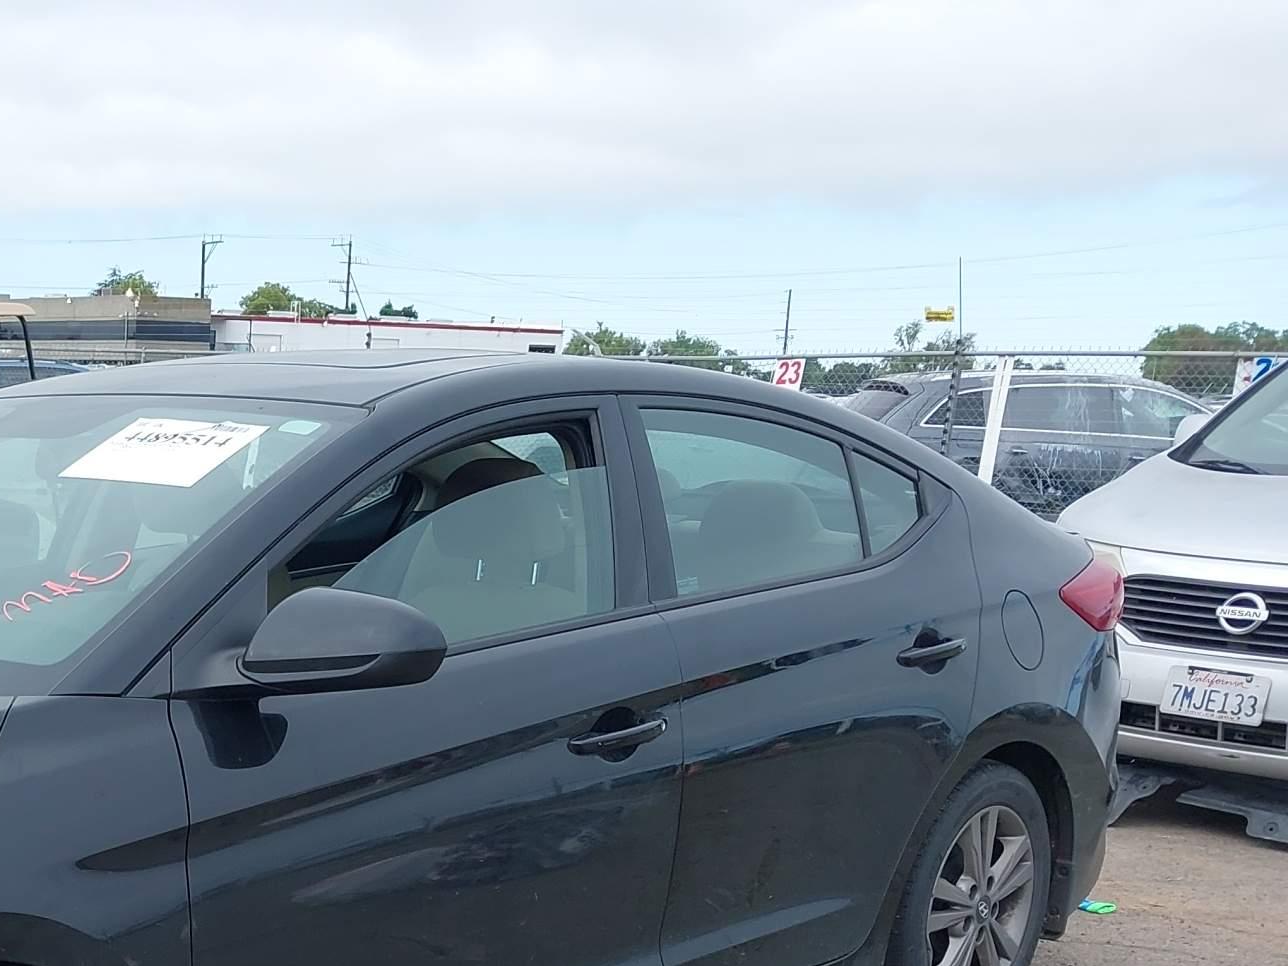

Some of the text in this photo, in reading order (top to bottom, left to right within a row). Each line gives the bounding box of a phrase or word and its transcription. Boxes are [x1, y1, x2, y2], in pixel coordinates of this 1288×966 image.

[776, 361, 802, 385] 23
[1219, 608, 1262, 618] NISSAN
[1188, 669, 1250, 690] California
[1170, 683, 1258, 718] 7MJE133
